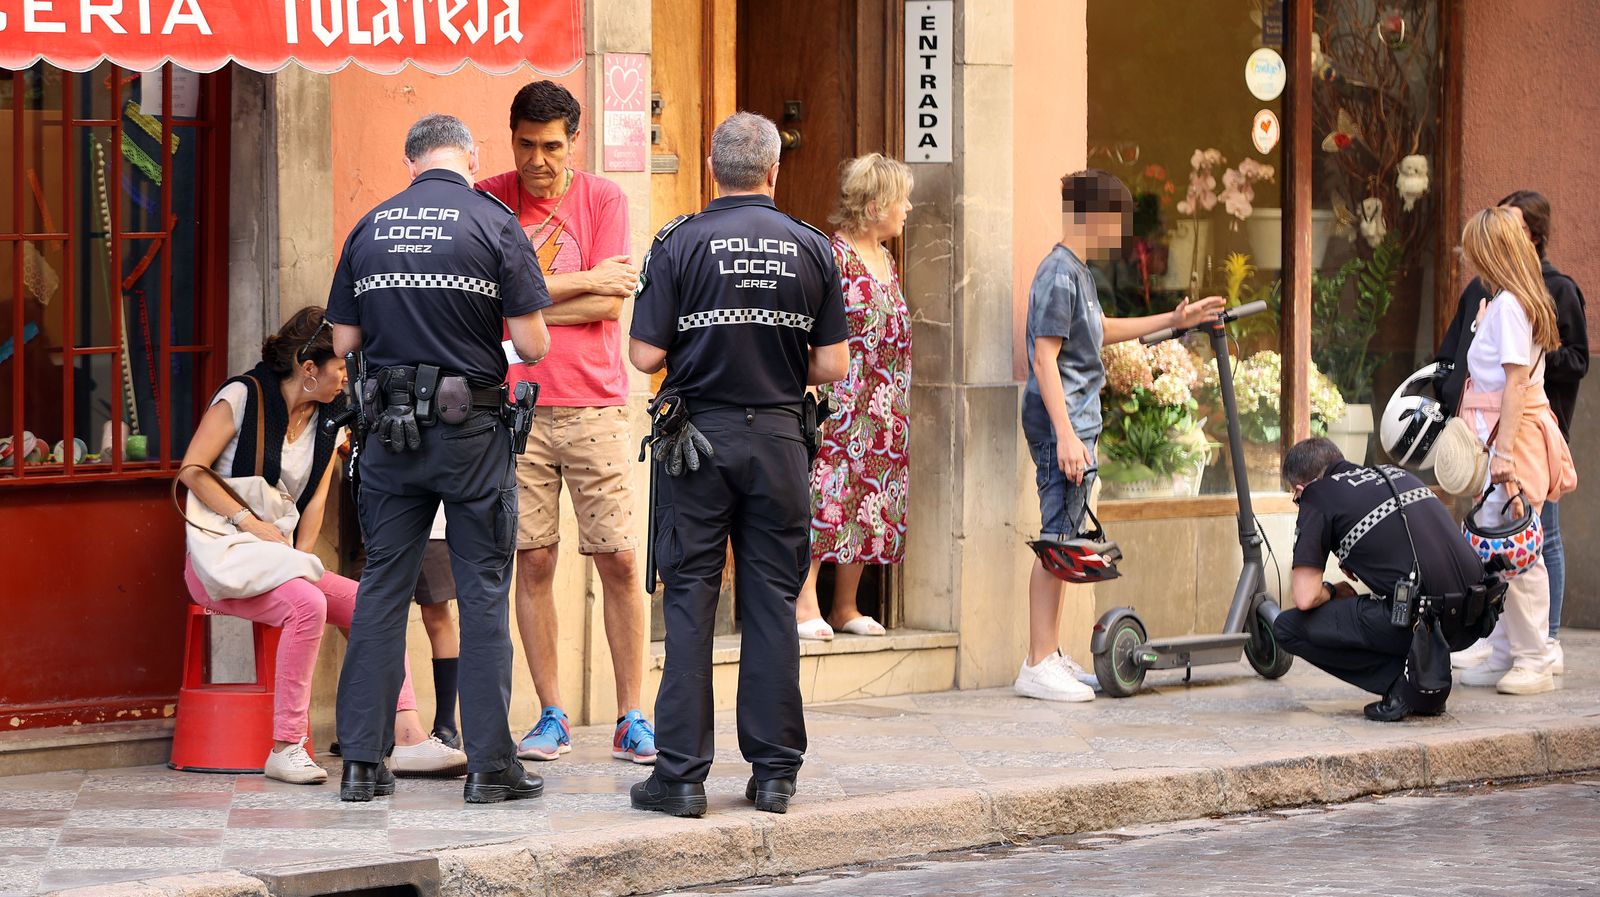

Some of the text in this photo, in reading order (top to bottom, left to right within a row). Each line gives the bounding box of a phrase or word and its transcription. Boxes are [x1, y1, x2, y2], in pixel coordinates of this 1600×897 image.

[0, 0, 213, 35] ERIA
[918, 16, 938, 148] ENTRADA
[374, 207, 460, 224] POLICIA
[374, 226, 453, 240] LOCAL
[388, 244, 433, 253] JEREZ
[710, 237, 798, 257] POLICIA
[718, 259, 796, 278] LOCAL
[735, 279, 778, 290] JEREZ
